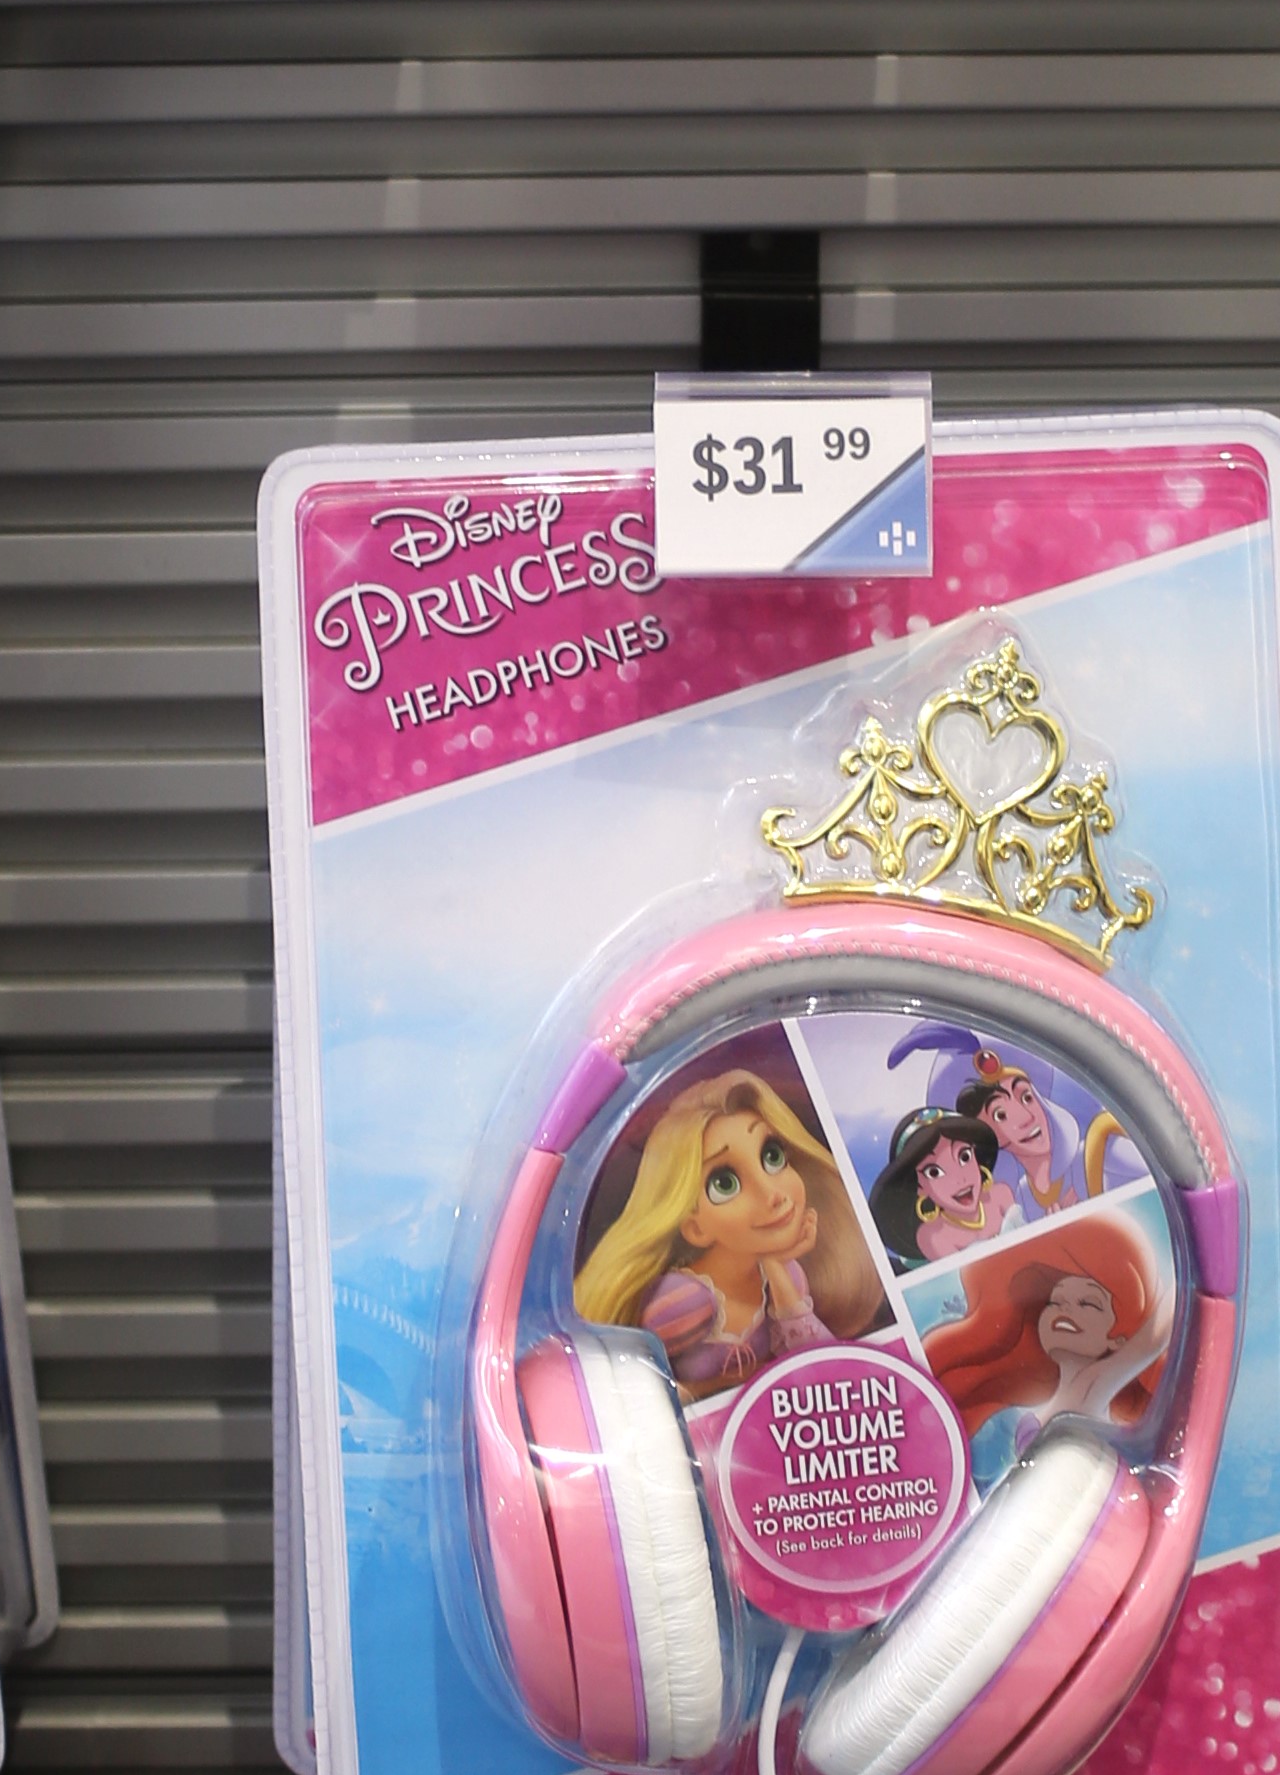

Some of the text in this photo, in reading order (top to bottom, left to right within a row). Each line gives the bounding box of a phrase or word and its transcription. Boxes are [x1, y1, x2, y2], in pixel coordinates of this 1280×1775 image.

[692, 428, 871, 501] $31 99
[372, 492, 562, 569] Disney
[315, 512, 665, 691] PRINCESS
[386, 616, 669, 731] HEADPHONES
[772, 1376, 898, 1418] BUILT-IN
[770, 1410, 905, 1452] VOLUME
[784, 1445, 900, 1485] LIMITER
[768, 1489, 851, 1514] PARENTAL
[855, 1478, 937, 1501] CONTROL
[754, 1499, 938, 1536] TO PROTECT HEARING
